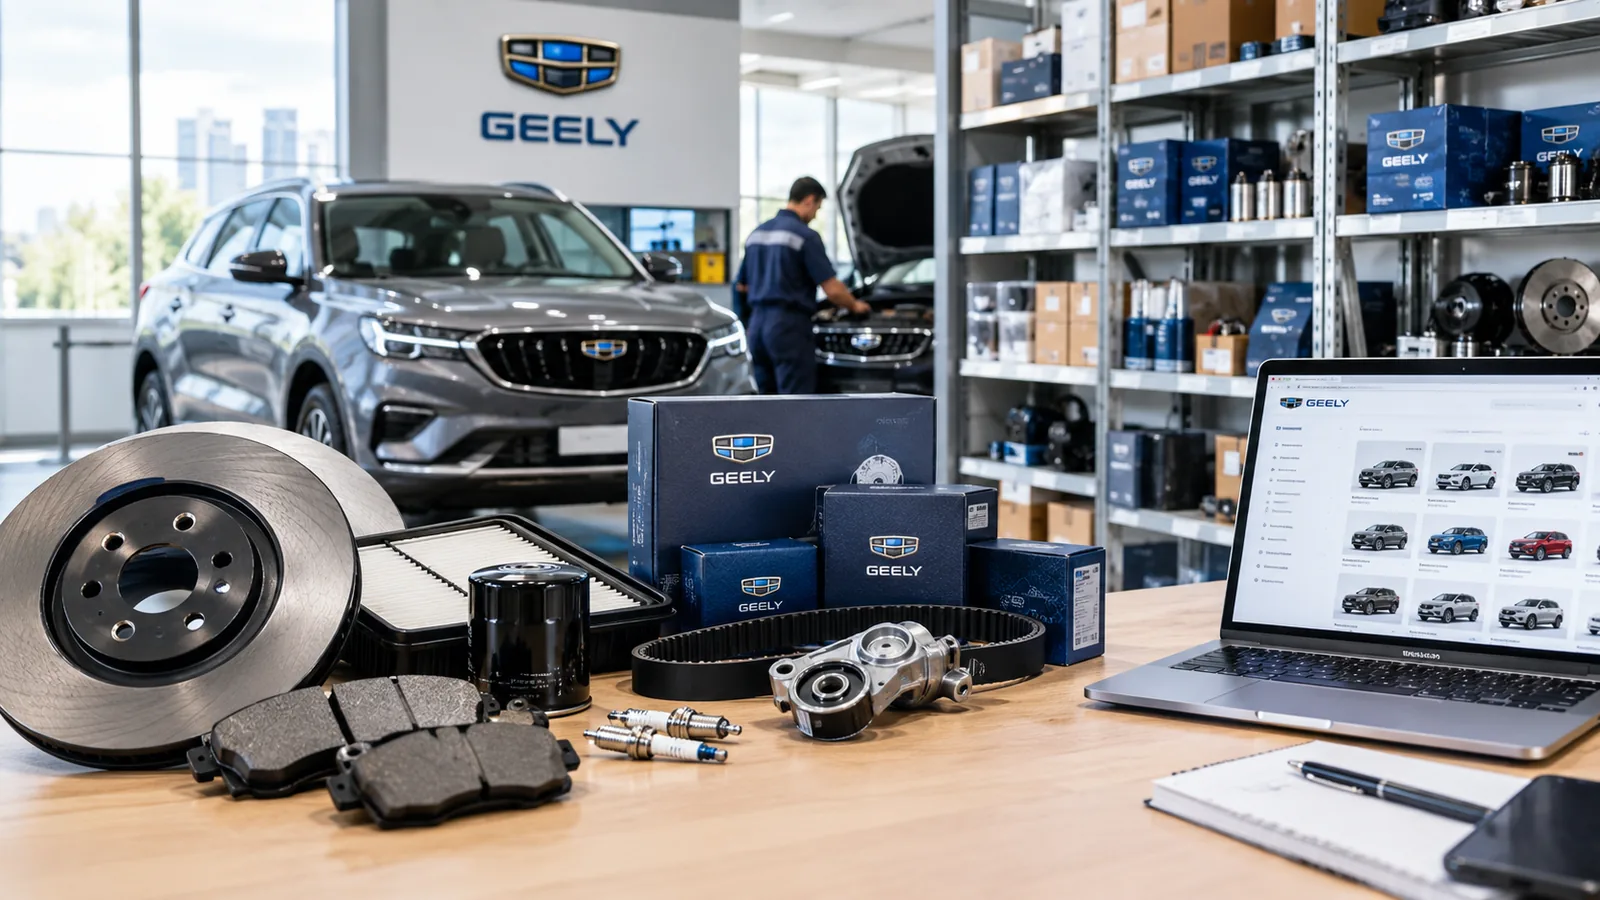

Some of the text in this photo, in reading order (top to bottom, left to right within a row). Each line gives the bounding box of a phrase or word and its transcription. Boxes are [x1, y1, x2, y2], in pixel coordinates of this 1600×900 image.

[480, 111, 639, 147] GEELY
[1382, 153, 1428, 167] GEELY
[1306, 399, 1349, 407] GEELY
[710, 470, 775, 485] GEELY
[866, 566, 922, 576] GEELY
[738, 600, 783, 612] GEELY
